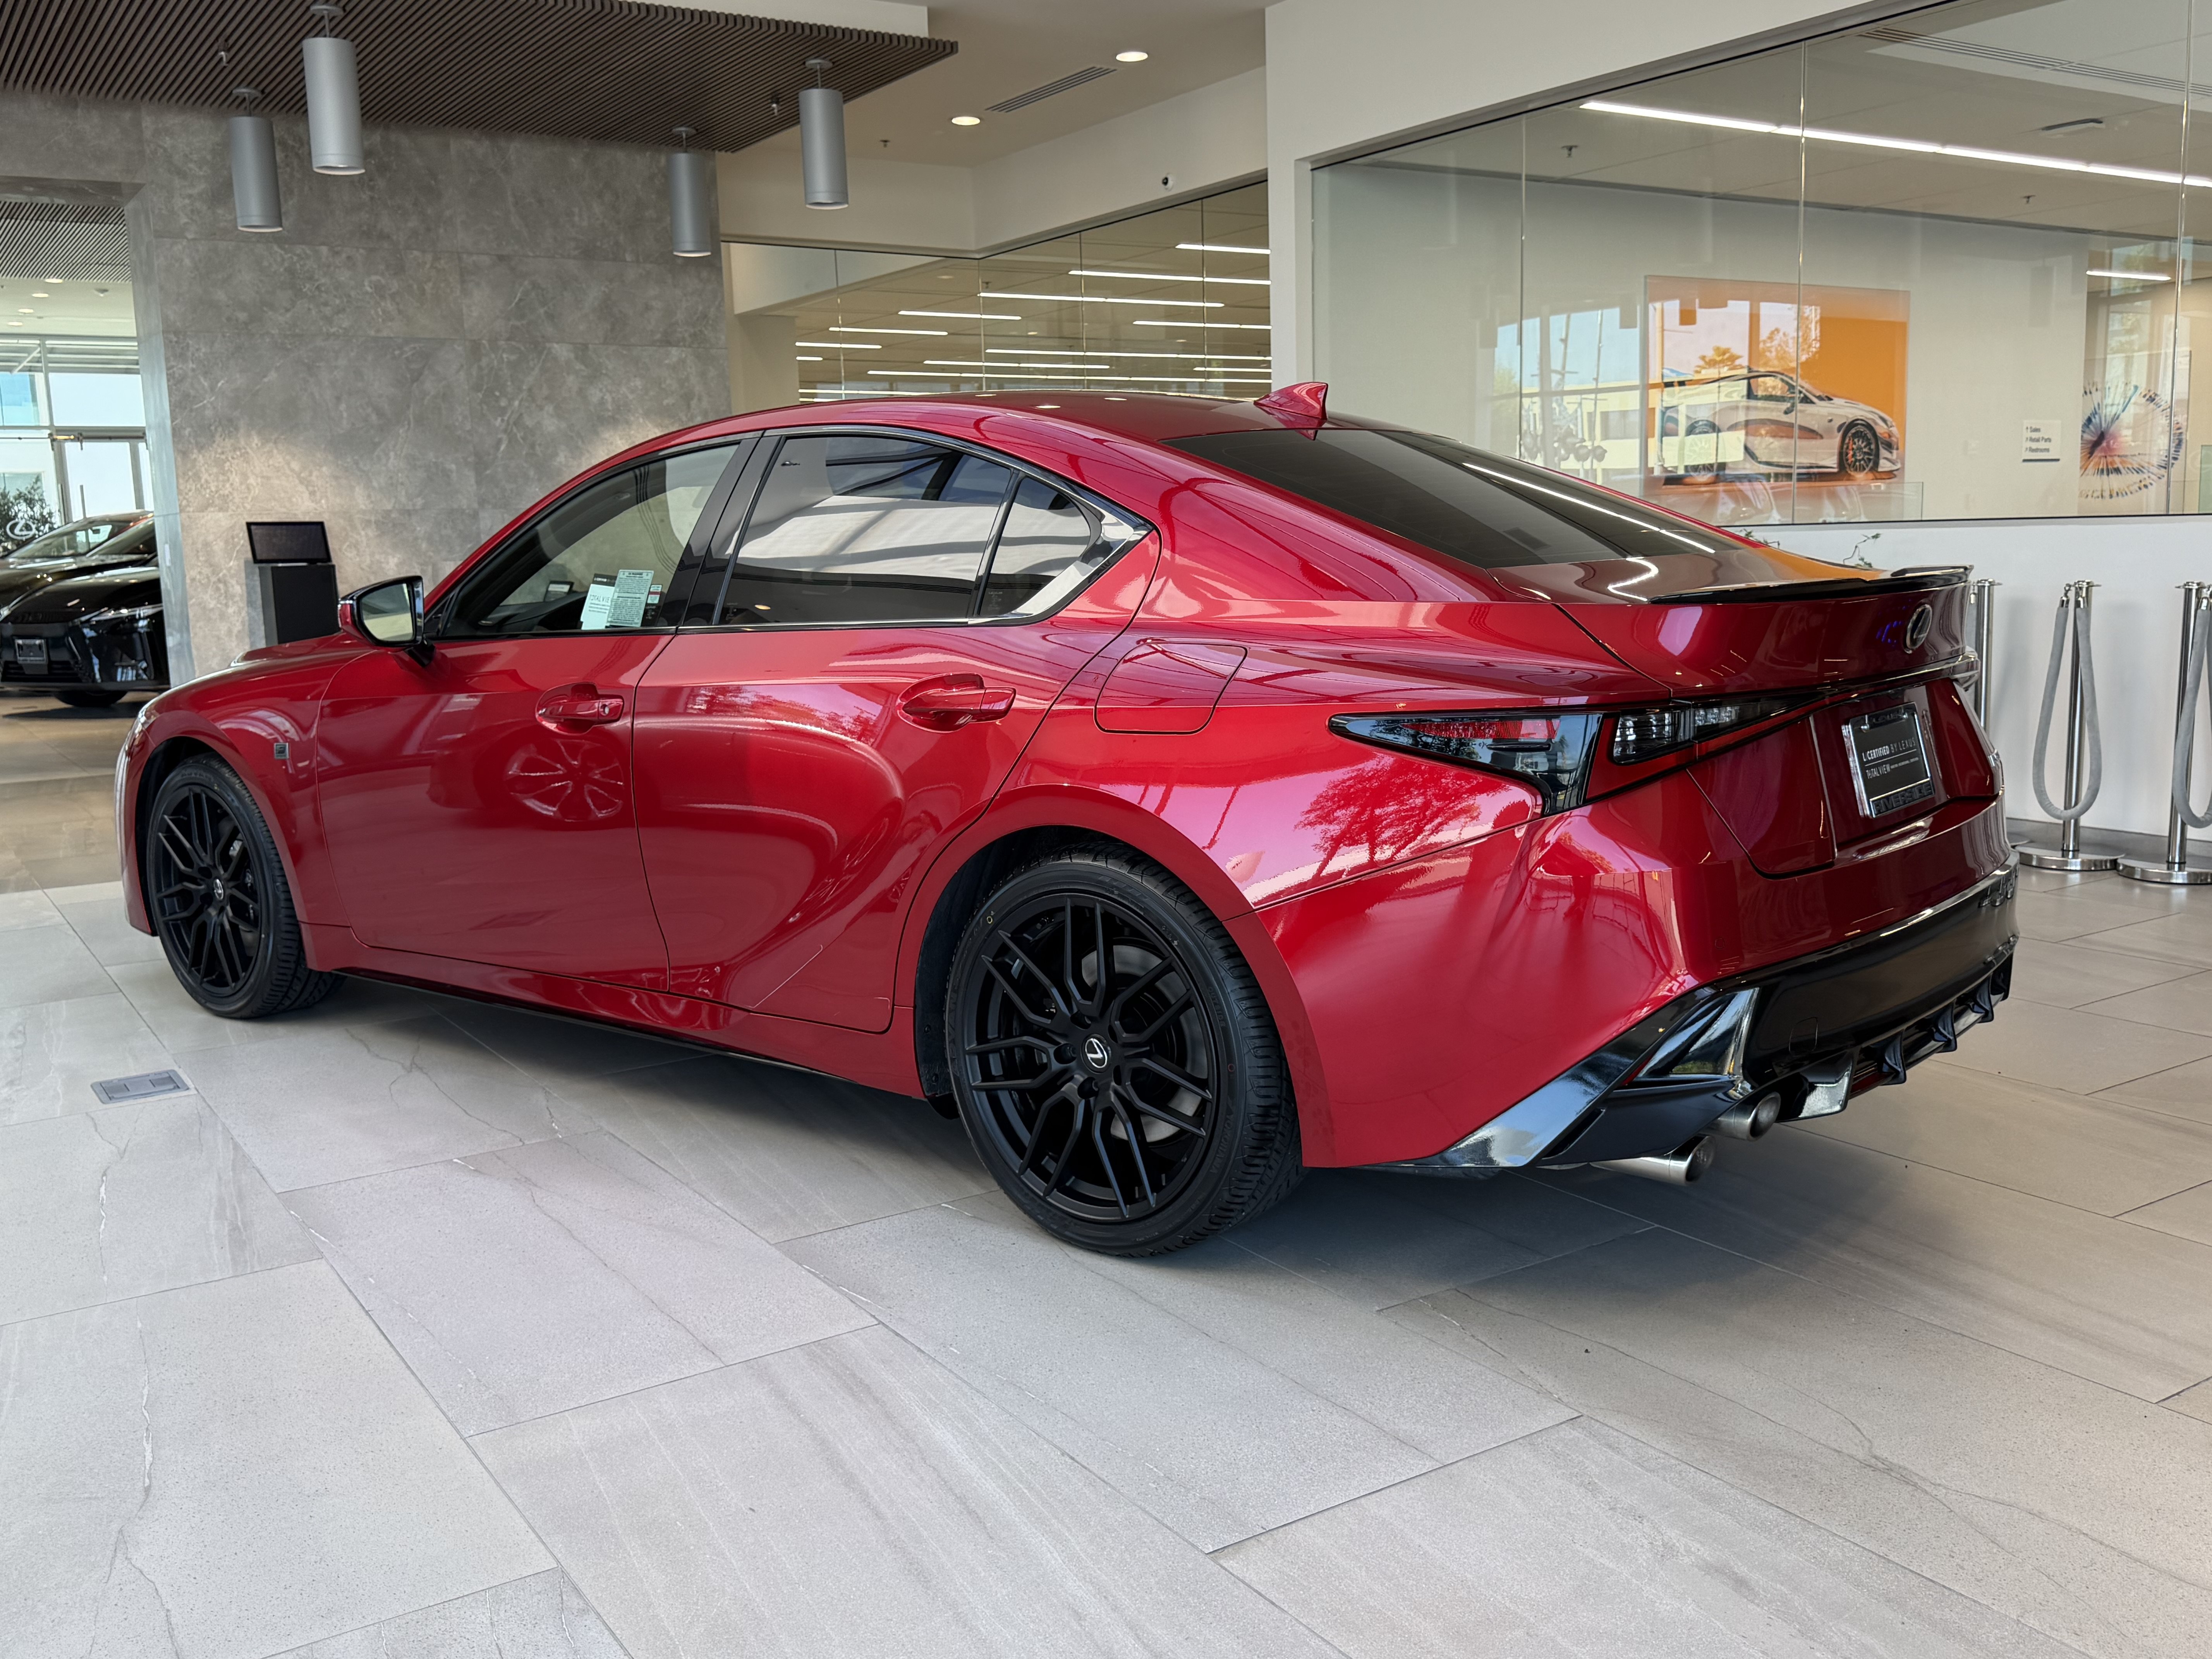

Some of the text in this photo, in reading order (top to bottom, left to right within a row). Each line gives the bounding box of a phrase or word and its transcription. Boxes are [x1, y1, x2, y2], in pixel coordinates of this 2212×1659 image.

[1899, 737, 1915, 750] LEXUS
[1874, 783, 1932, 814] RIVERSIDE
[1209, 1115, 1234, 1173] YOKOHAMA
